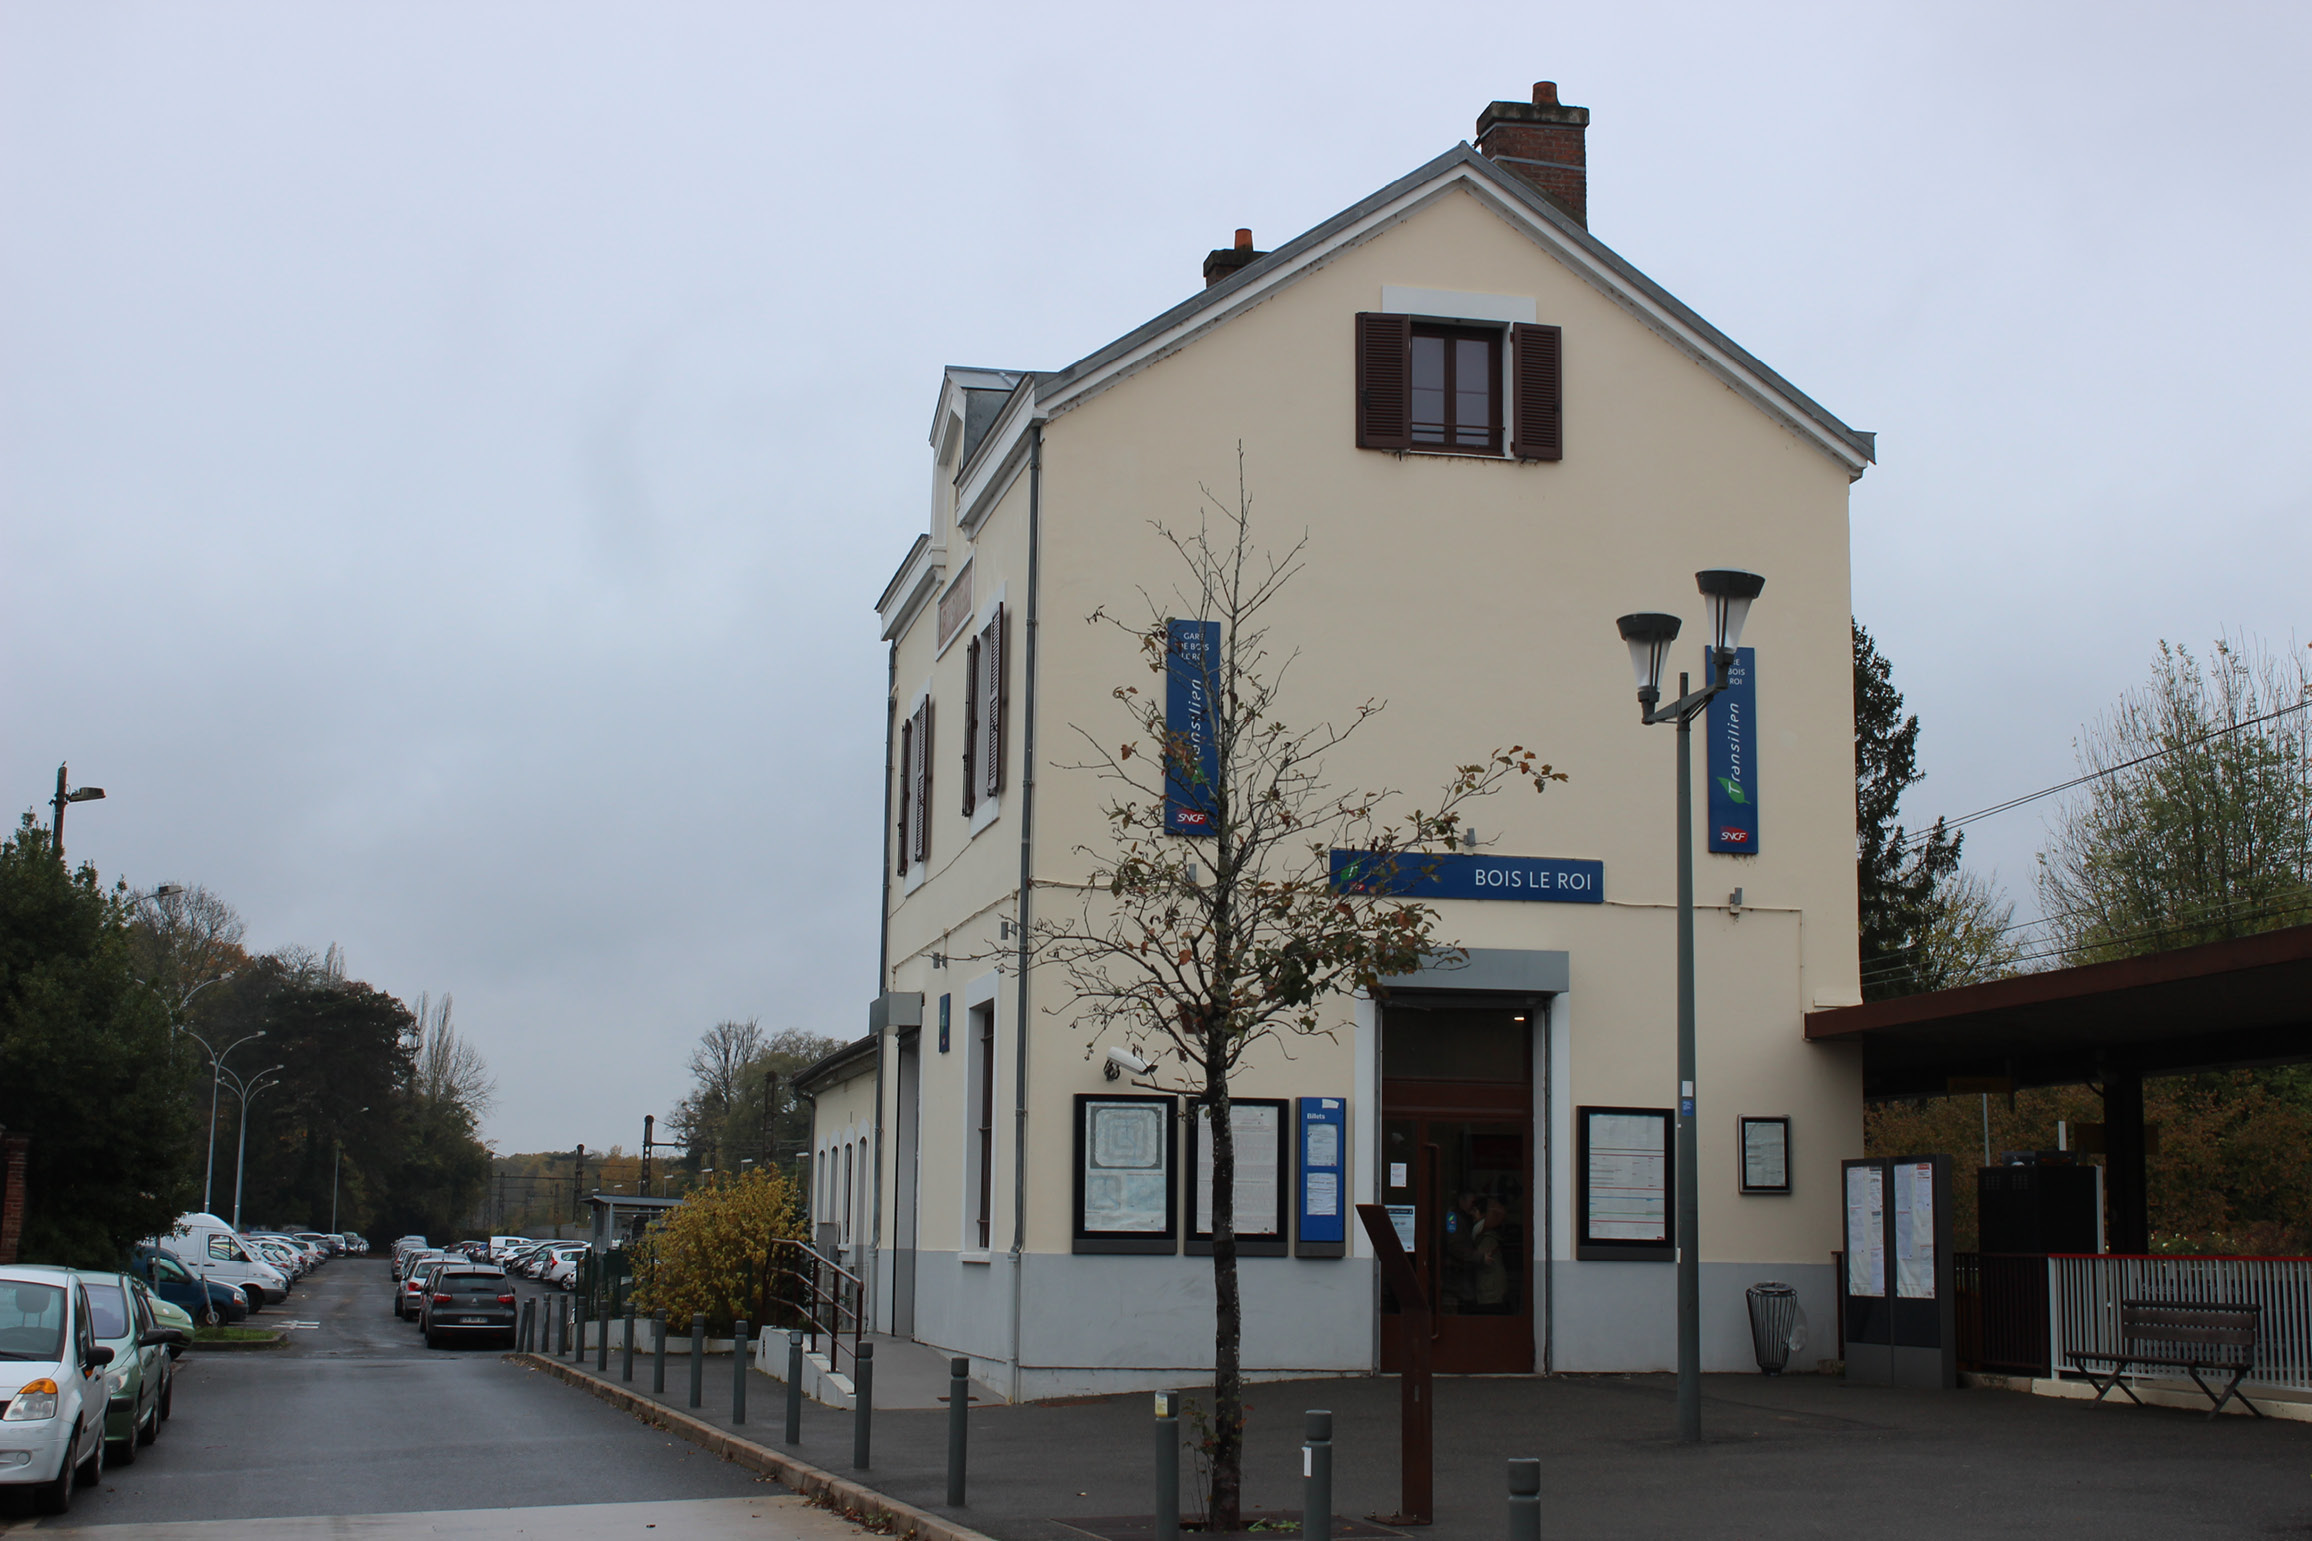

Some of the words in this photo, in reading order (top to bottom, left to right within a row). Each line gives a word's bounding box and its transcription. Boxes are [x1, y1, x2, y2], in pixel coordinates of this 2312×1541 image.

[1729, 677, 1743, 685] ROI
[1727, 703, 1741, 794] Transilien
[1177, 813, 1206, 823] SNCF
[1720, 831, 1747, 841] SNCF
[1475, 869, 1522, 888] BOIS
[1529, 871, 1551, 889] LE
[1557, 872, 1591, 891] ROI
[1306, 1112, 1326, 1120] Billets
